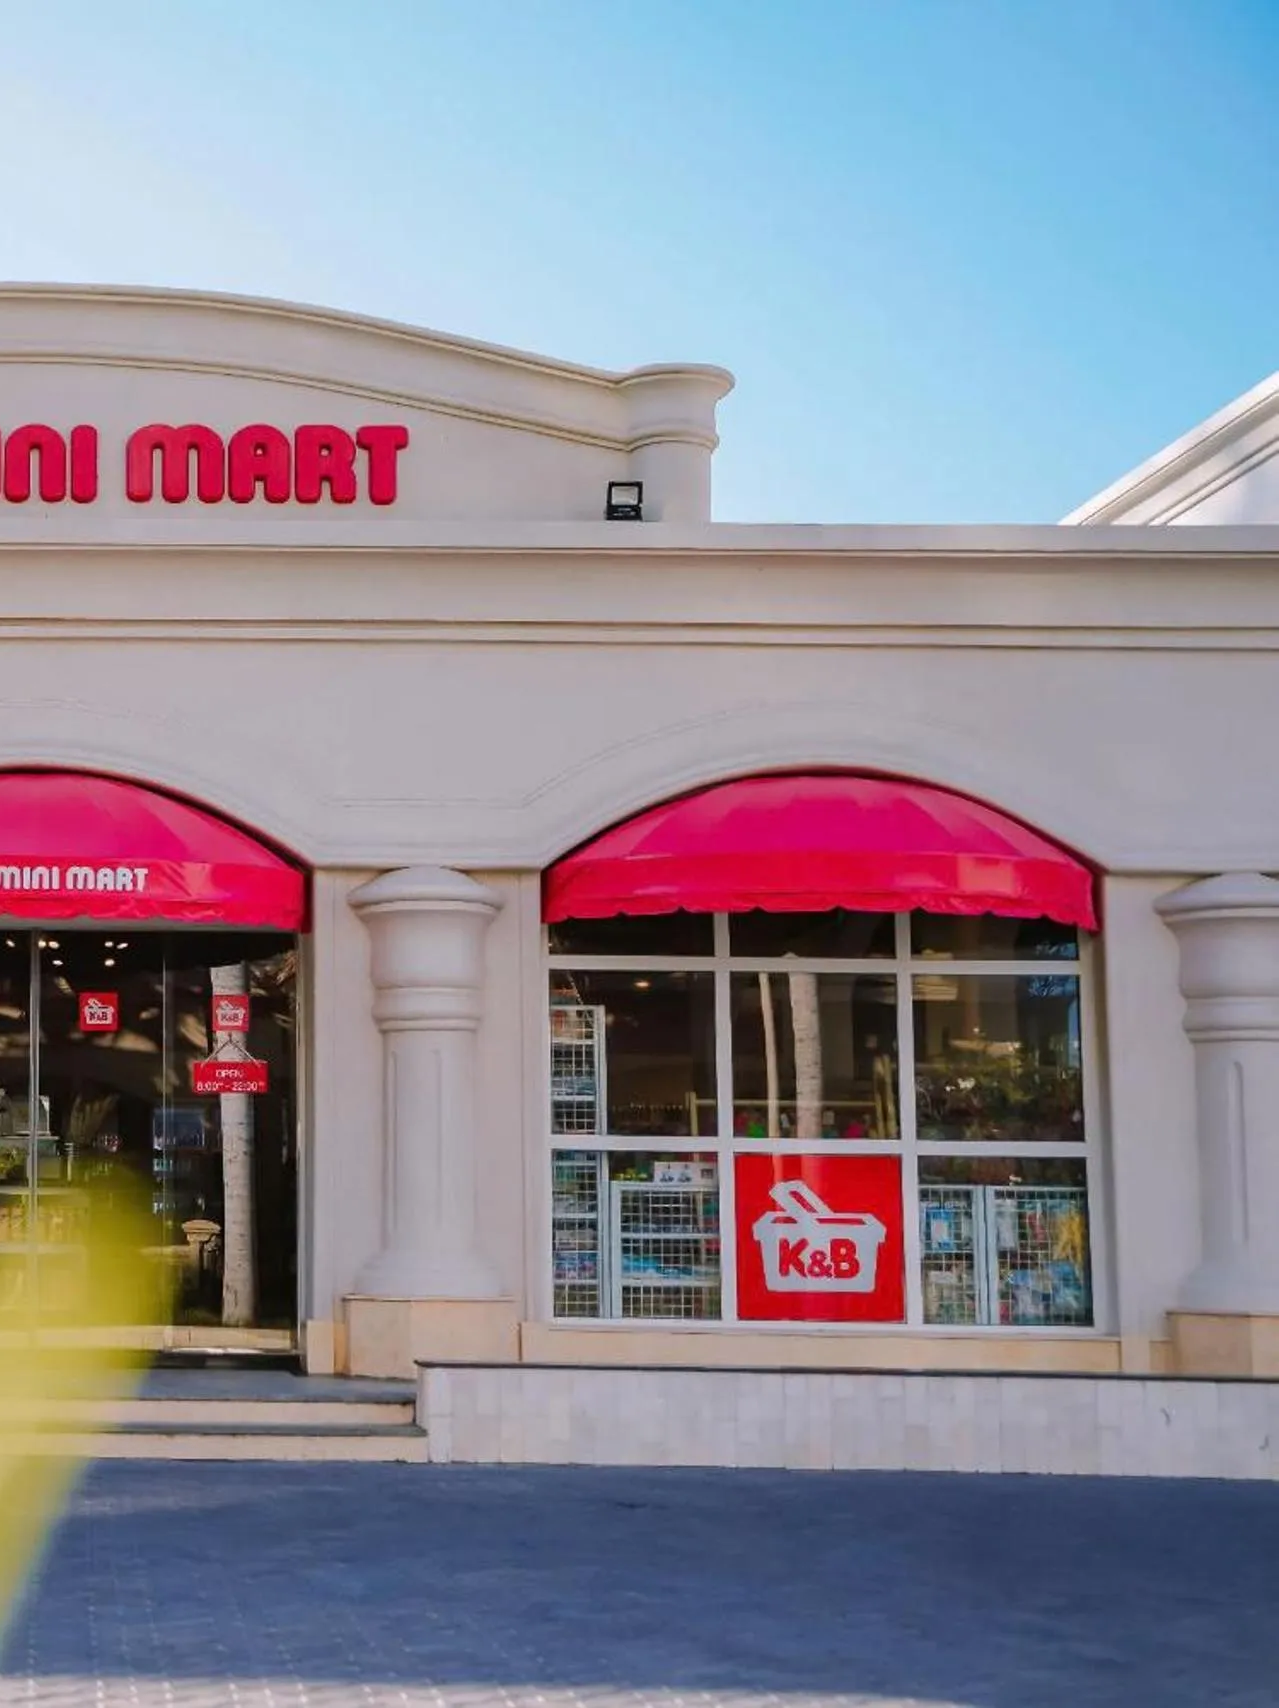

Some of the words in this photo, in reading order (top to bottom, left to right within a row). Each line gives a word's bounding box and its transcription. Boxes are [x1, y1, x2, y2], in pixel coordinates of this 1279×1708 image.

[125, 423, 410, 505] MART
[65, 866, 149, 892] MART
[778, 1237, 860, 1279] K&B
